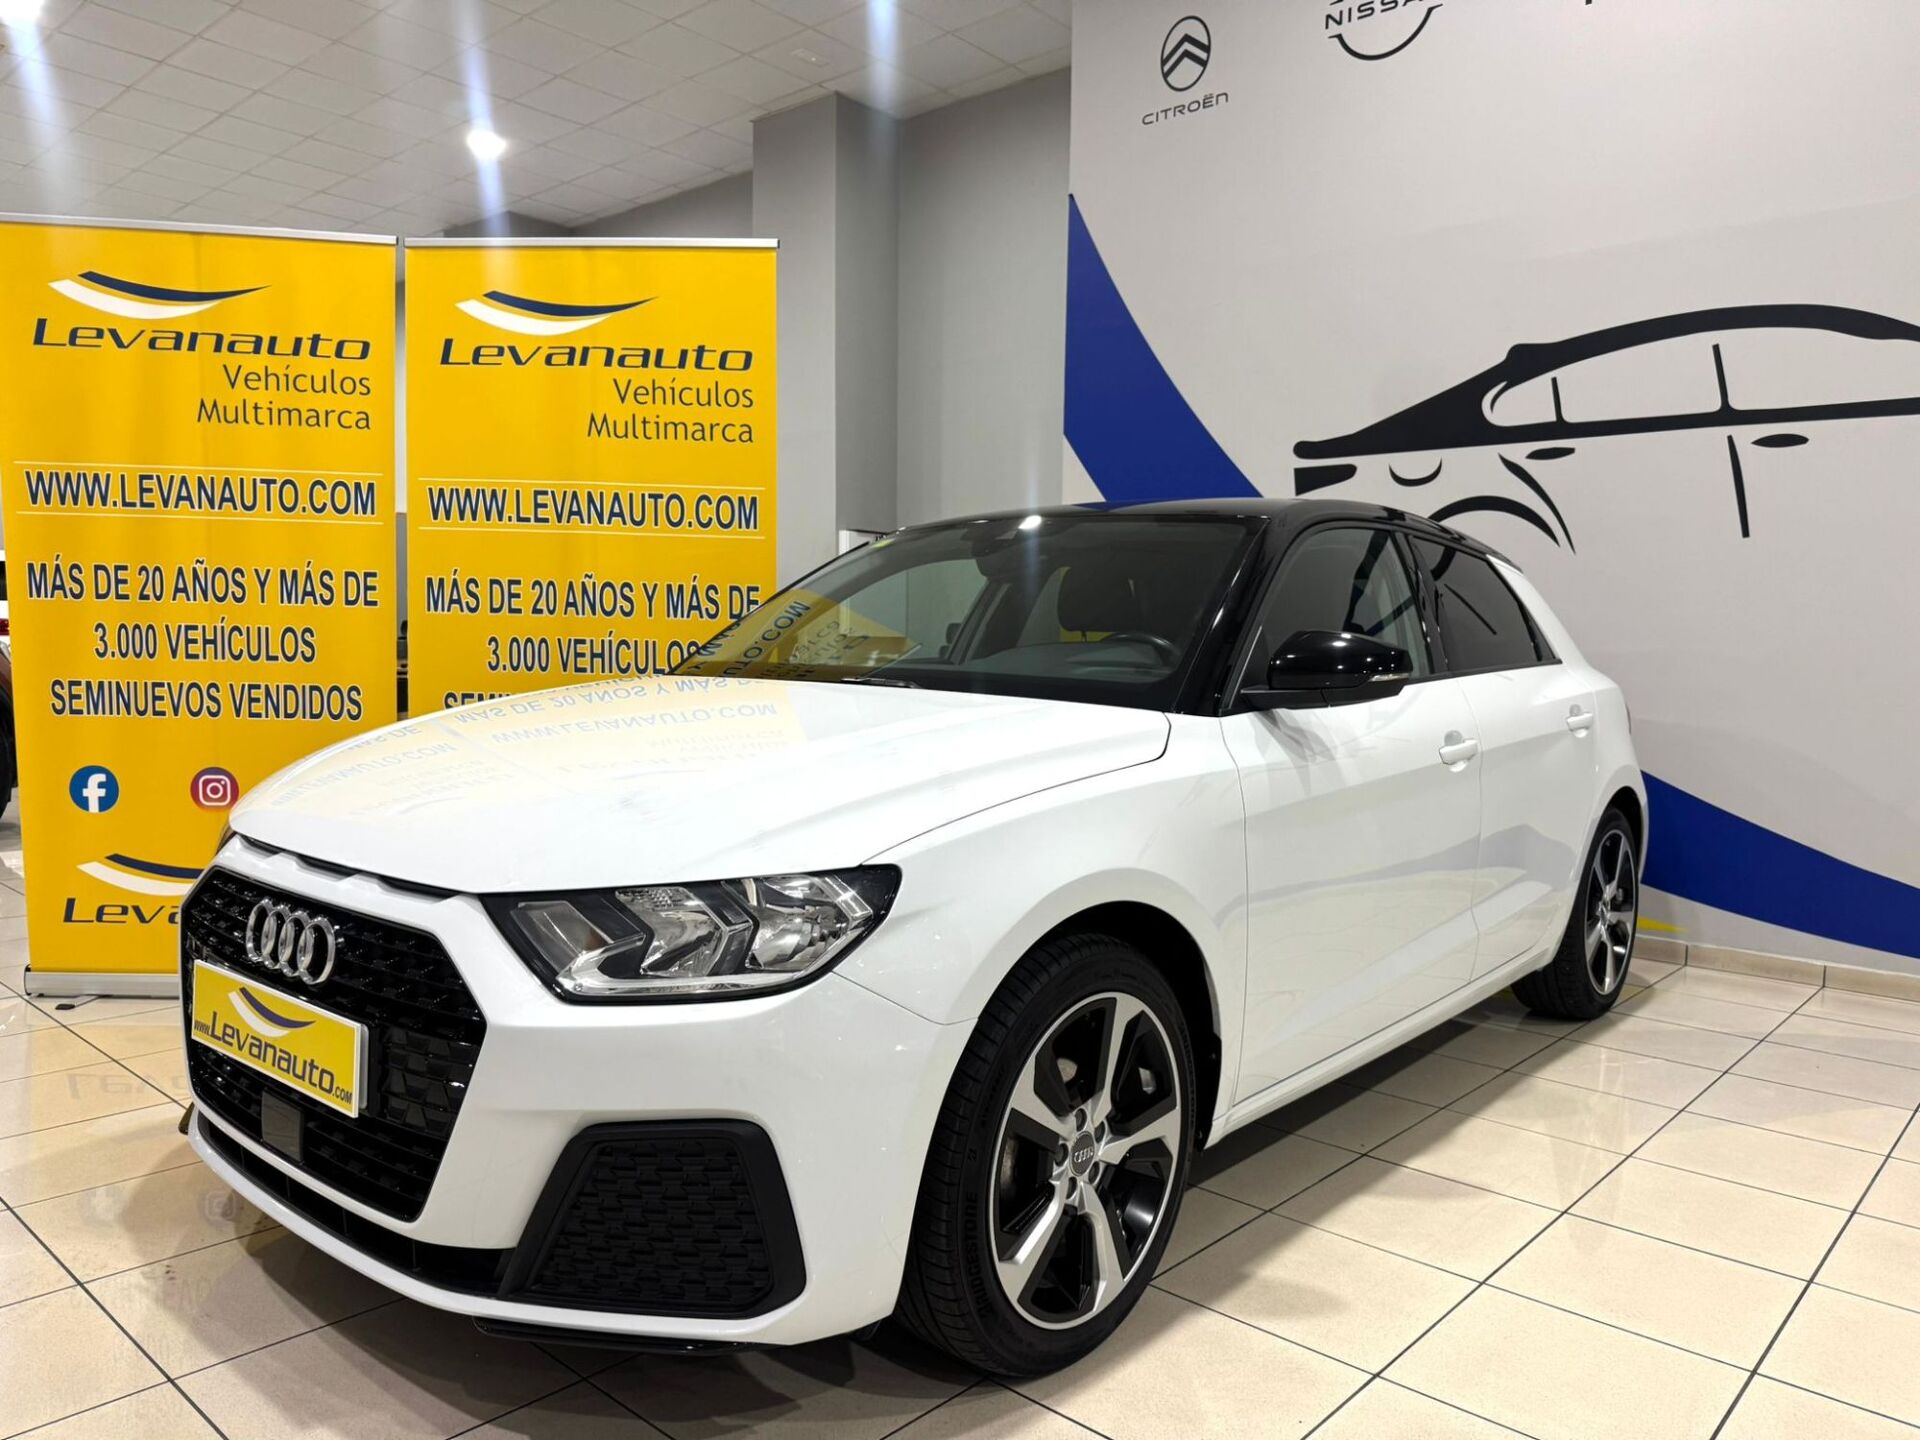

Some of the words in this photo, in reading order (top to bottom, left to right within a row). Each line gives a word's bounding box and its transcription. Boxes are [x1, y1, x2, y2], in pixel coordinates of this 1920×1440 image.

[33, 318, 371, 361] Levanauto
[440, 338, 753, 371] Levanauto
[223, 363, 371, 396] Vehículos
[613, 377, 754, 409] Vehículos
[197, 397, 371, 430] Multimarca
[587, 412, 754, 443] Multimarca
[25, 470, 376, 516] WWW.LEVANAUTO.COM
[428, 487, 758, 530] WWW.LEVANAUTO.COM
[27, 554, 85, 600] MÁS
[94, 564, 129, 600] DE
[138, 565, 164, 602] 20
[172, 559, 246, 603] AÑOS
[254, 568, 271, 604] Y
[279, 561, 335, 606] MÁS
[344, 571, 379, 607] DE
[426, 569, 480, 613] MÁS
[489, 579, 524, 614] DE
[531, 580, 557, 615] 20
[563, 574, 635, 618] AÑOS
[642, 583, 659, 617] Y
[666, 575, 720, 620] MÁS
[729, 585, 760, 619] DE
[94, 622, 157, 660] 3.000
[164, 616, 316, 663] VEHÍCULOS
[488, 637, 550, 673] 3.000
[51, 679, 221, 718] SEMINUEVOS
[229, 683, 363, 722] VENDIDOS
